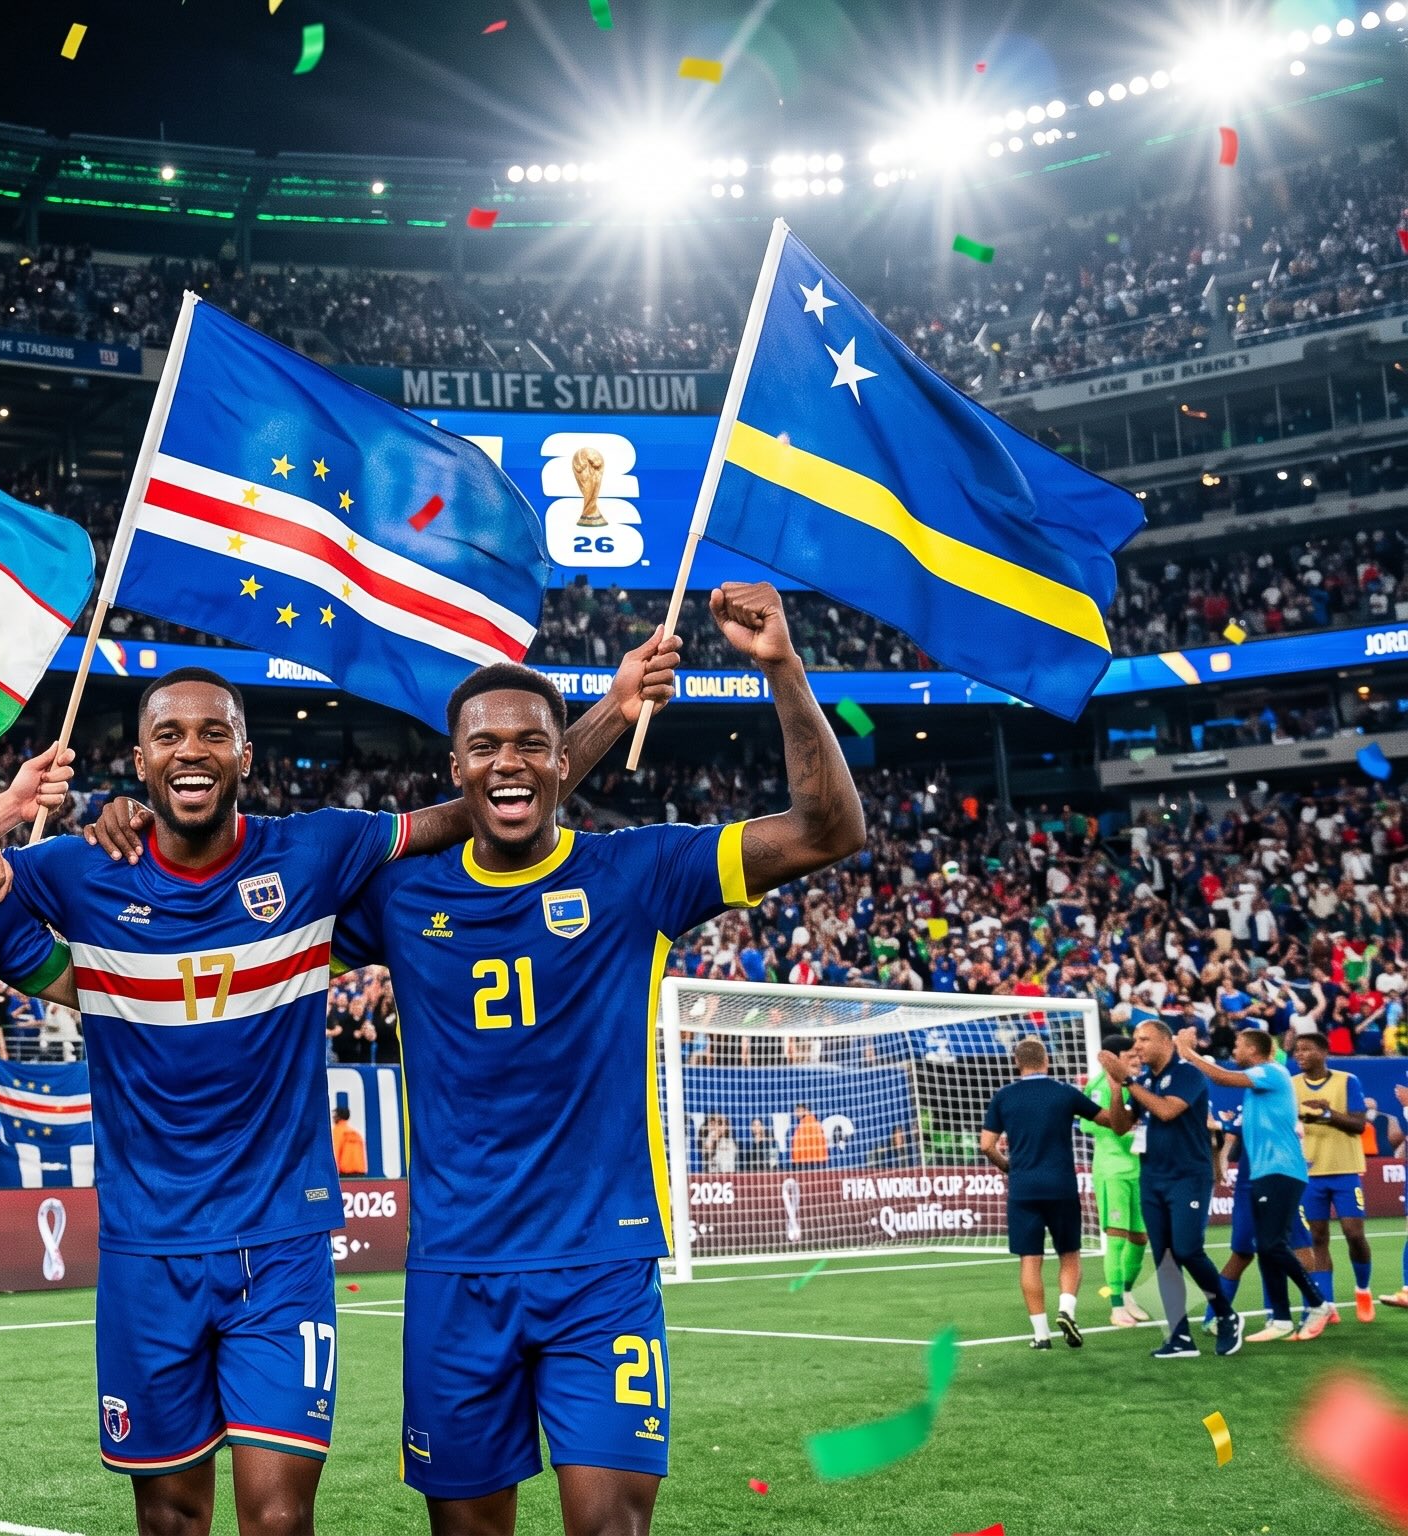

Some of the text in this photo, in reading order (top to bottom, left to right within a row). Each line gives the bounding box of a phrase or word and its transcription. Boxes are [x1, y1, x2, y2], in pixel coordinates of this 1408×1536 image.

[402, 370, 697, 411] METLIFE STADIUM
[573, 536, 615, 553] 26
[685, 673, 760, 698] QUALIFIÉS
[177, 953, 236, 1021] 17
[472, 956, 536, 1030] 21
[343, 1191, 397, 1218] 2026
[689, 1182, 735, 1205] 2026
[842, 1174, 1005, 1200] FIFA WORLD CUP 2026
[879, 1203, 974, 1238] Qualifiers
[298, 1321, 335, 1392] 17
[613, 1335, 666, 1409] 21
